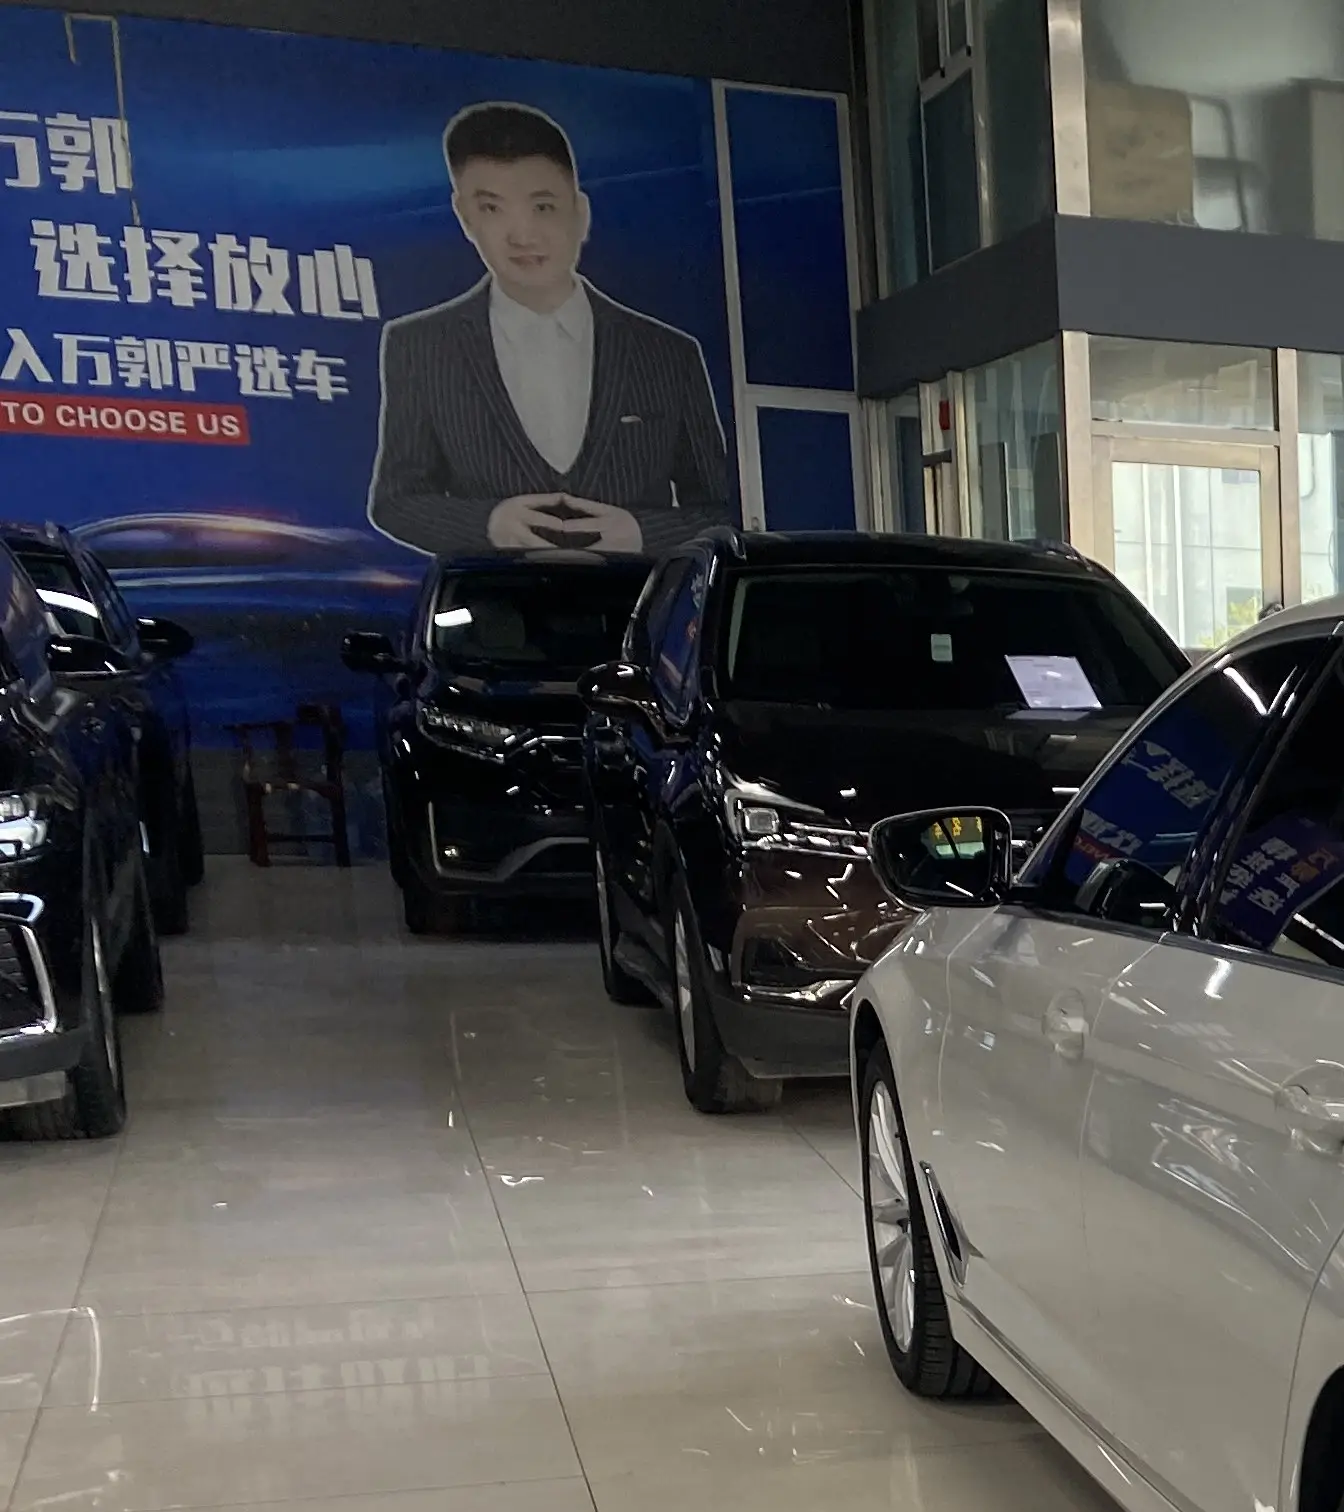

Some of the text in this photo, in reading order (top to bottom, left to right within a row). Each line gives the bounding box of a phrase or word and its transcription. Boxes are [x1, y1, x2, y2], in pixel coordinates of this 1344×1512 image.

[29, 218, 380, 320] 选择放心
[0, 328, 349, 401] 入万郭严选车
[0, 401, 242, 437] TO CHOOSE US
